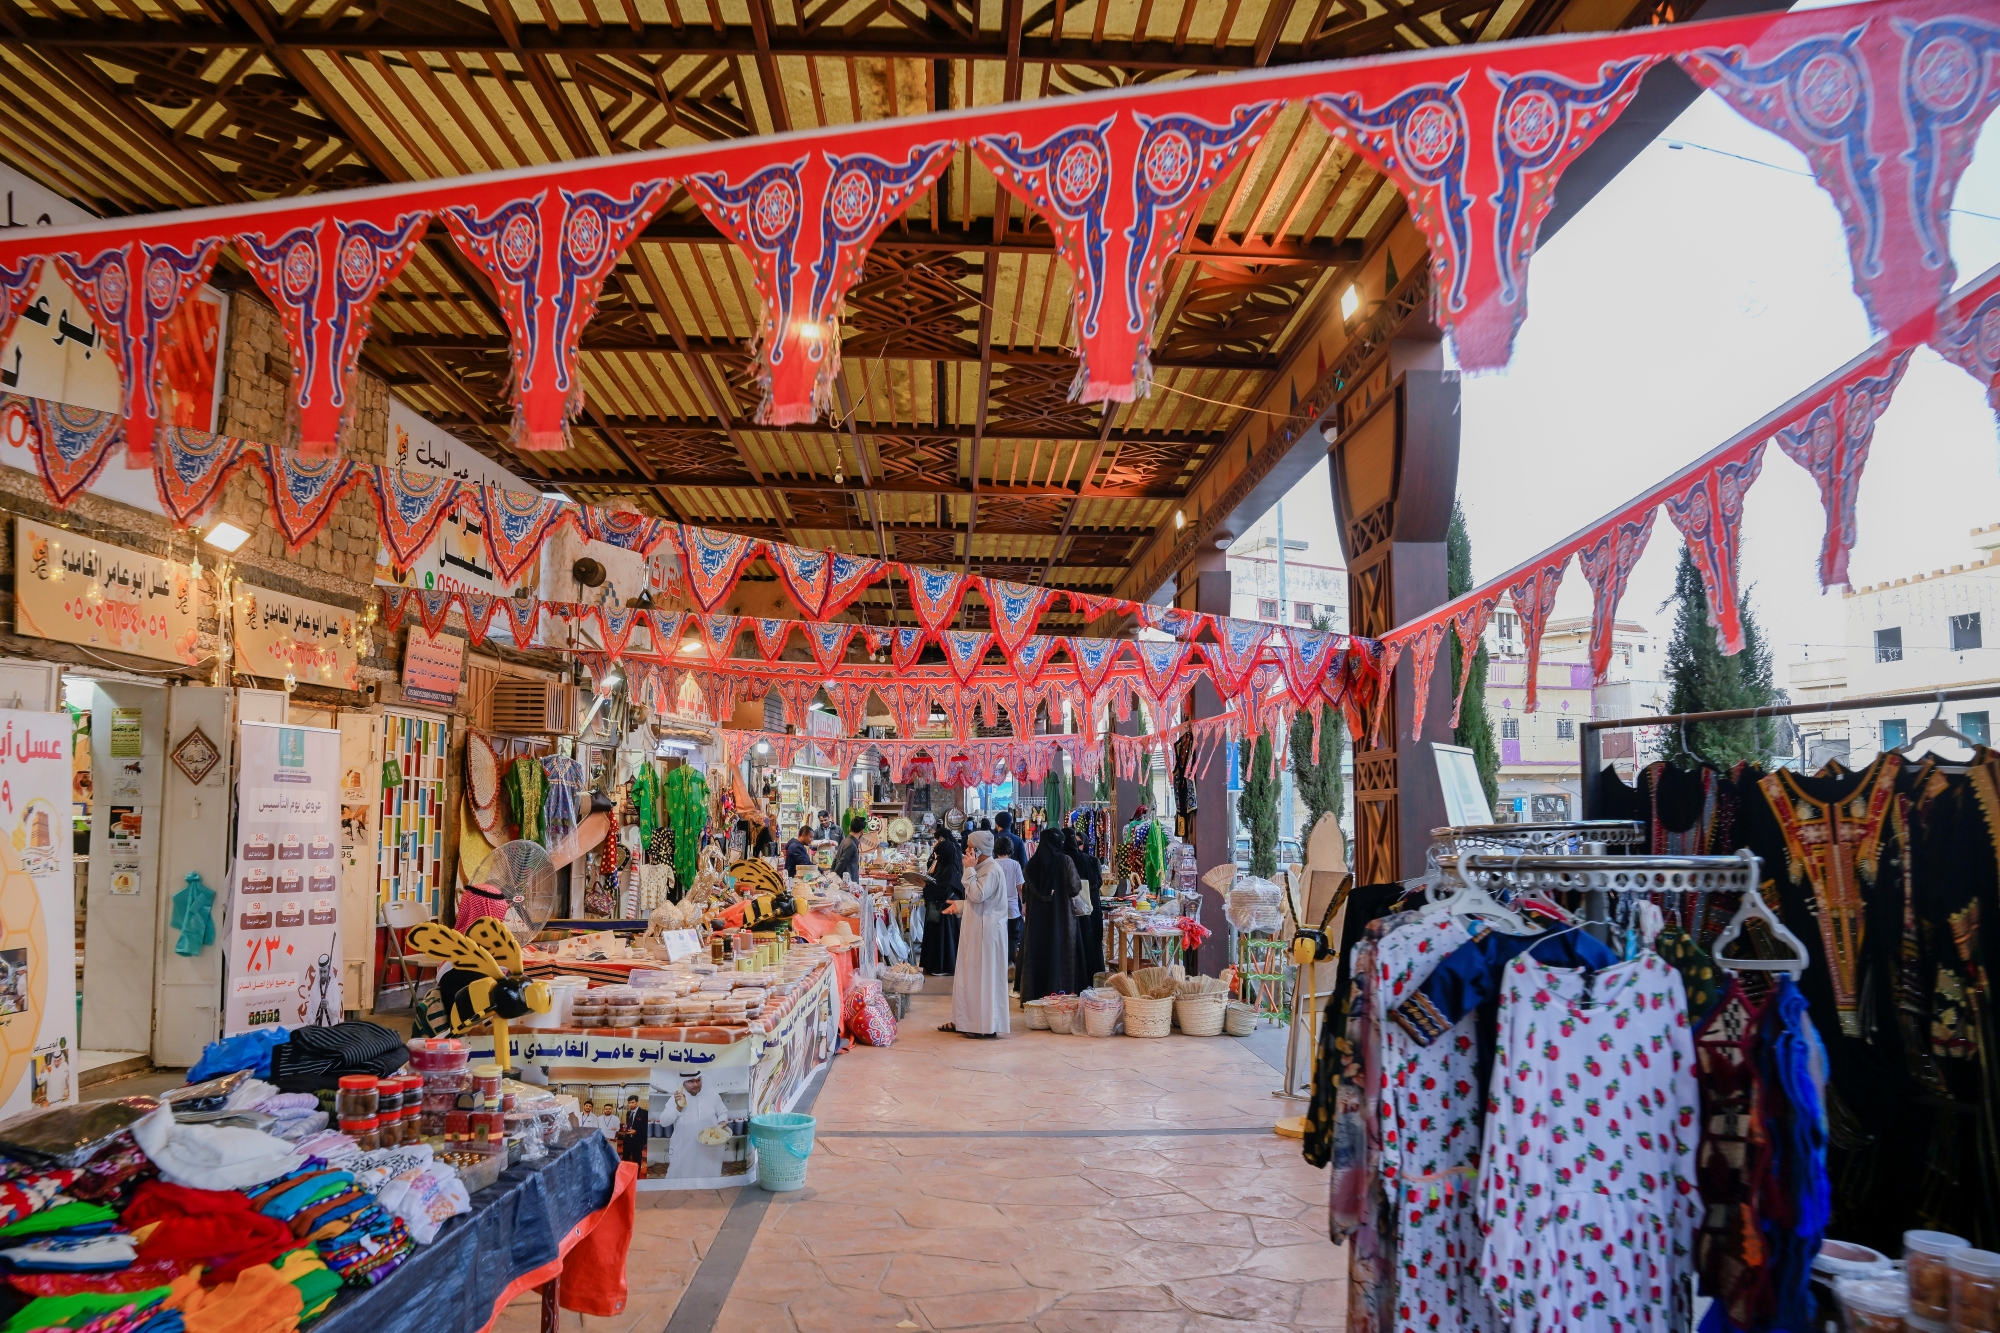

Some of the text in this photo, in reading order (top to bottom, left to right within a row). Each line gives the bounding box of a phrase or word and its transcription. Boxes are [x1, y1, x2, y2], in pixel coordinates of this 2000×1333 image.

[103, 560, 129, 589] عامر
[131, 562, 146, 599] أبو
[148, 570, 170, 600] عسل
[263, 603, 338, 639] عسل أبو عامر الغامدي
[0, 720, 62, 764] عسل أب
[290, 801, 300, 814] يوم
[302, 799, 322, 813] عروض
[524, 1041, 589, 1065] الغامدي
[591, 1043, 635, 1063] عامر
[638, 1040, 664, 1063] أبو
[668, 1047, 716, 1064] محلات
